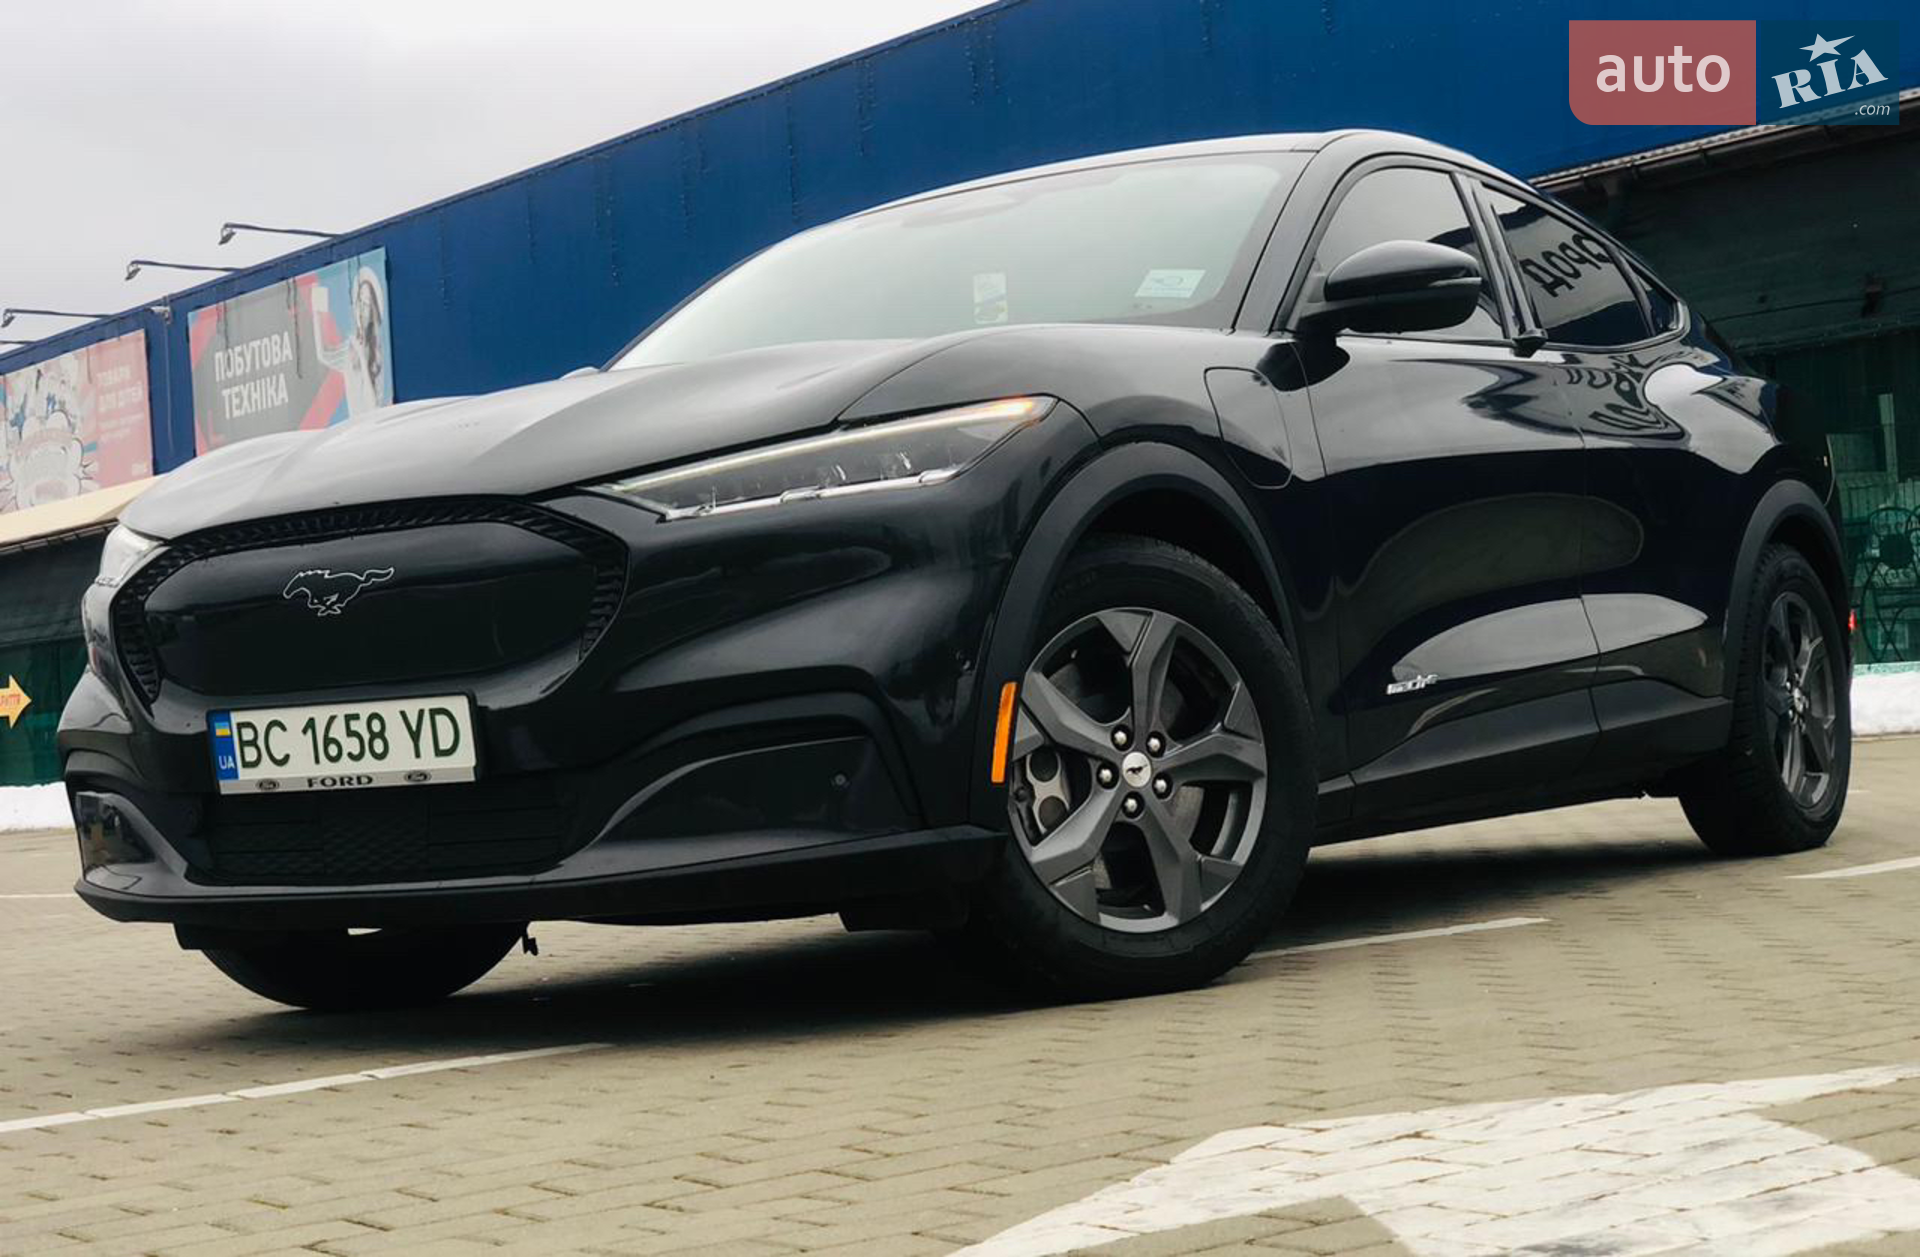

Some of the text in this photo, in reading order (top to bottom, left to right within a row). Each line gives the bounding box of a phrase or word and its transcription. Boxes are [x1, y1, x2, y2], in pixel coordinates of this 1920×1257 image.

[214, 331, 293, 382] ПОБУТОВА
[221, 373, 289, 420] ТЕХНІКА
[236, 707, 460, 769] BC 1658 YD
[218, 755, 235, 770] UA
[307, 774, 374, 788] FORD
